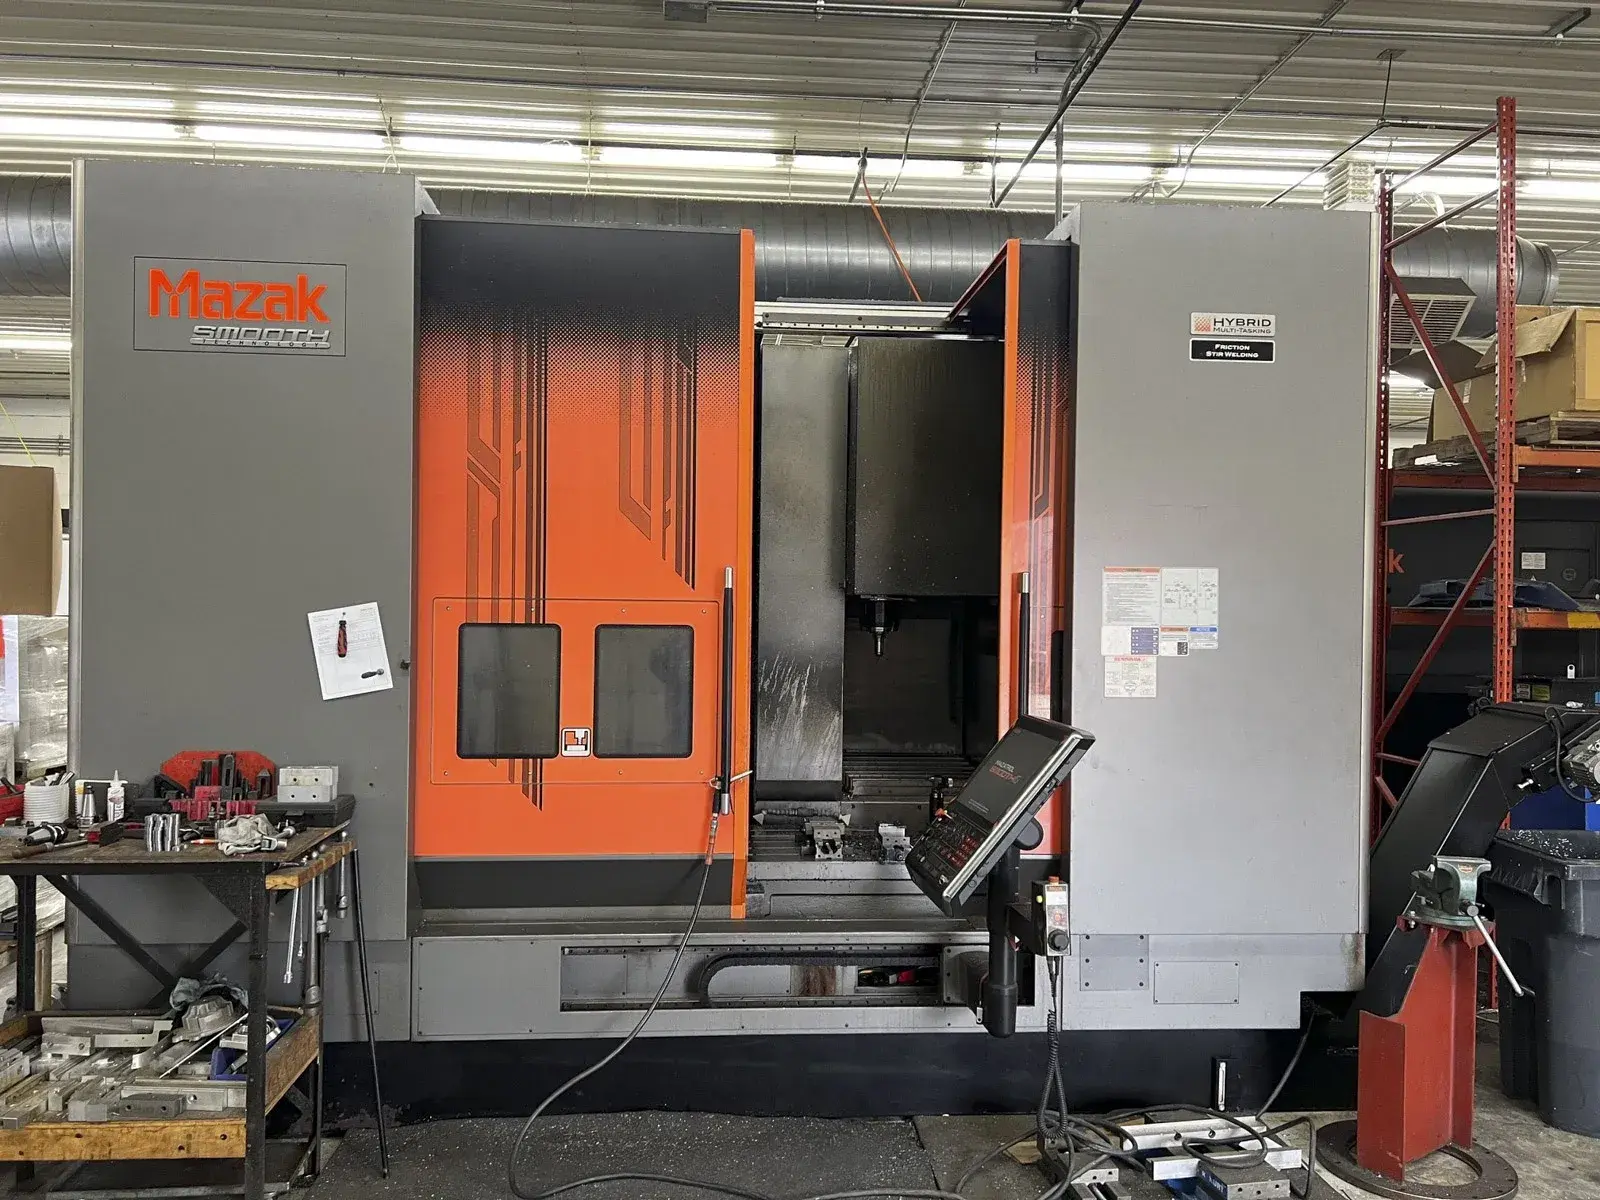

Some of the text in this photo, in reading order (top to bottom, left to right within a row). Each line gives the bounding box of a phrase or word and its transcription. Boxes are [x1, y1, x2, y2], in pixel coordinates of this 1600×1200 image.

[149, 268, 330, 323] Mazak
[1213, 318, 1272, 327] HYBRID
[193, 325, 330, 342] SMOOTH
[202, 339, 319, 347] TECHNOLOGY
